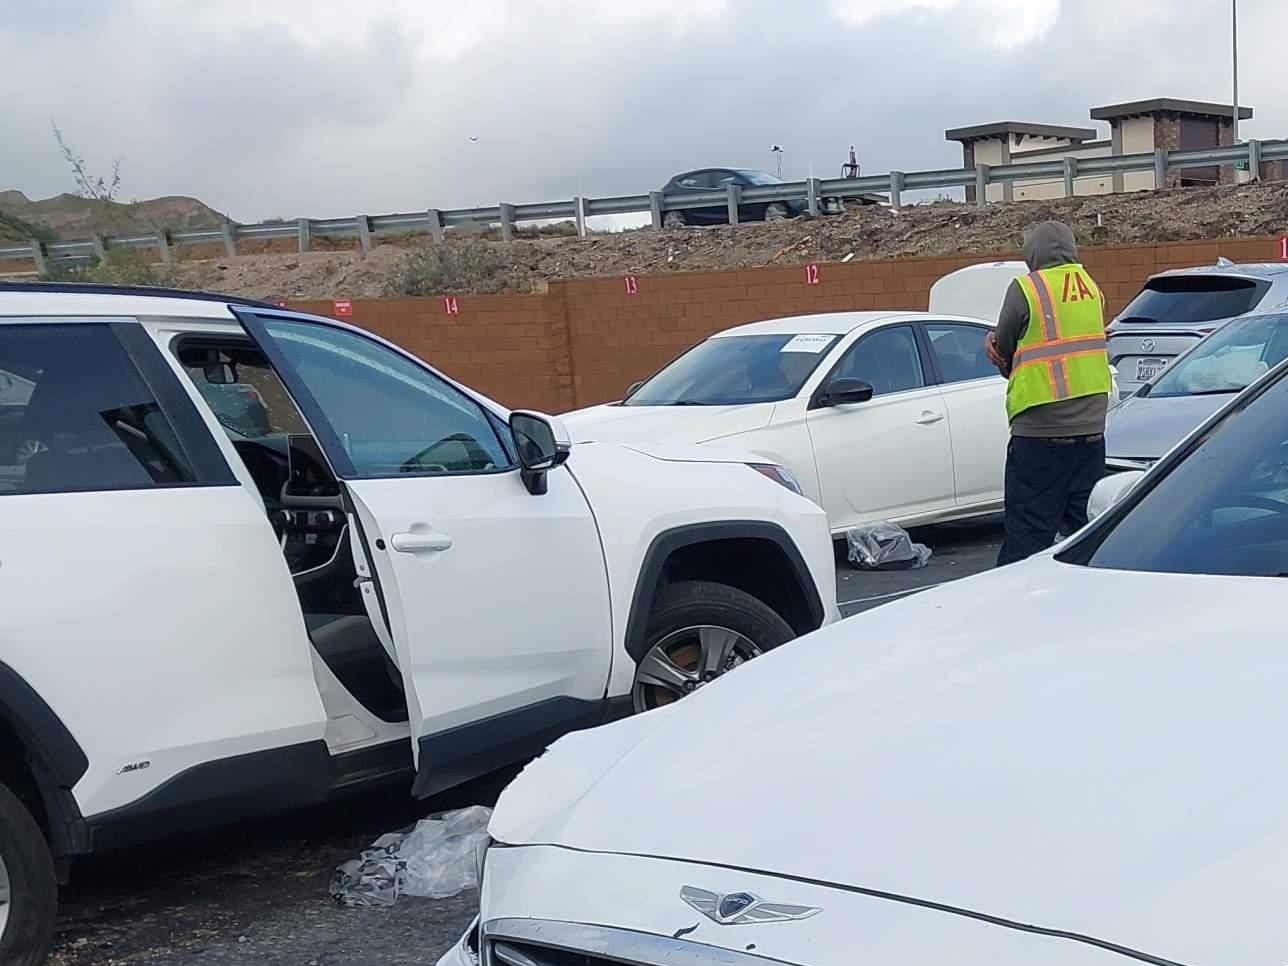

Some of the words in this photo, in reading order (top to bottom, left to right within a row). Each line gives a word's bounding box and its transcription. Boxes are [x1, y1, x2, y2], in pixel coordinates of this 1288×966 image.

[806, 265, 818, 284] 12
[625, 276, 637, 294] 13
[445, 297, 458, 314] 14
